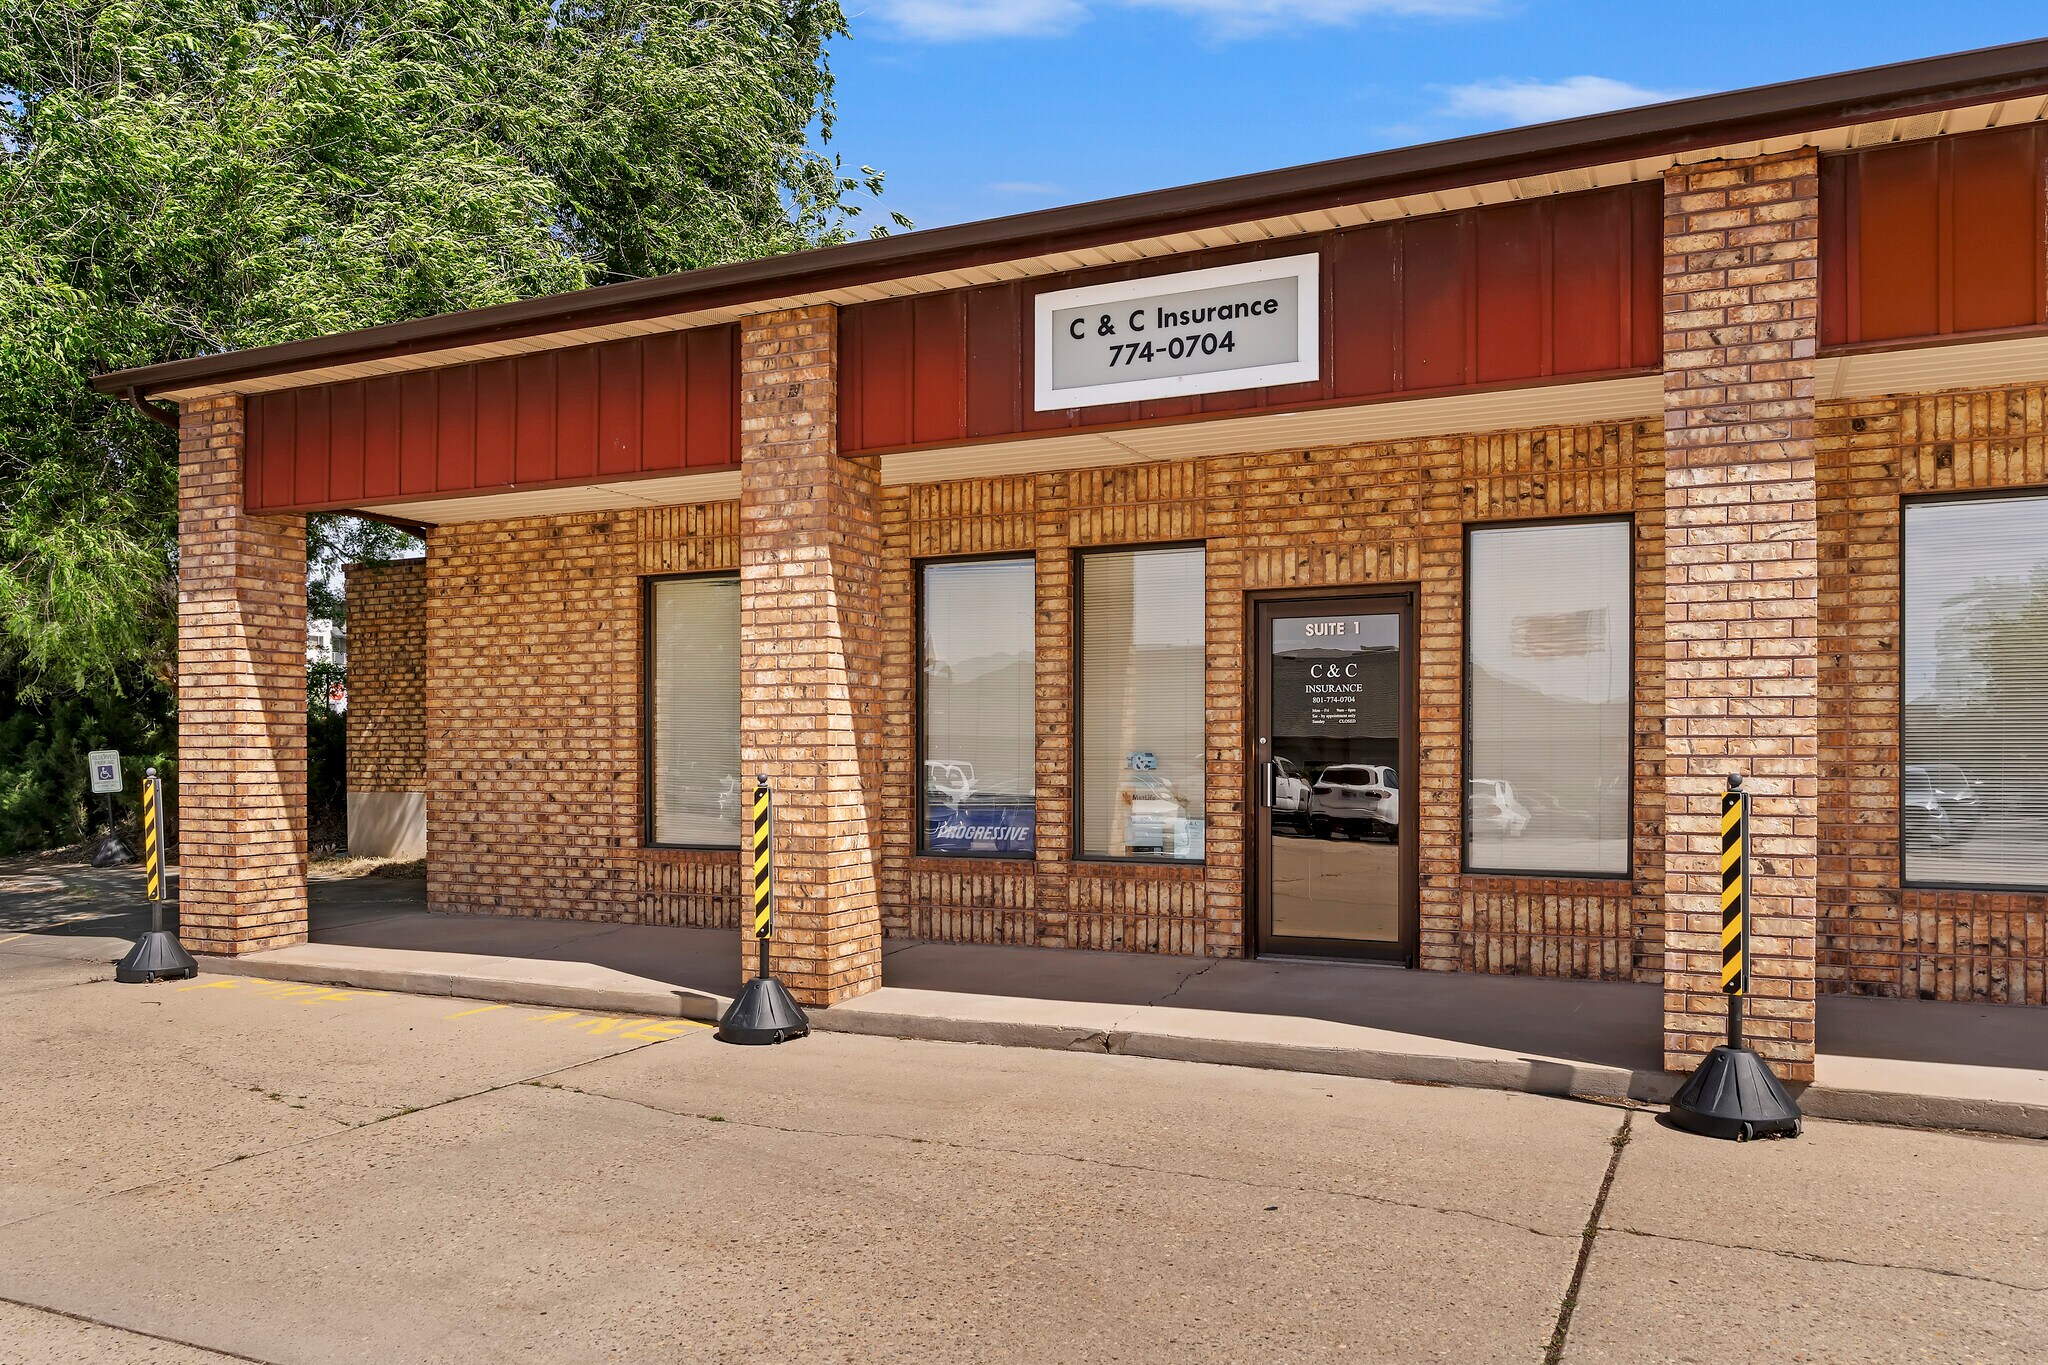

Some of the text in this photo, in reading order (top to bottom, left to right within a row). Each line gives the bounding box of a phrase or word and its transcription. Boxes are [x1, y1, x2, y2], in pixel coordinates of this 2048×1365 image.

[1070, 298, 1279, 339] C & C Insurance
[1109, 330, 1235, 367] 774-0704
[1305, 621, 1360, 637] SUITE 1
[1310, 663, 1358, 678] C & C
[1305, 684, 1363, 693] INSURANCE
[937, 826, 1029, 841] PROGRESSIVE
